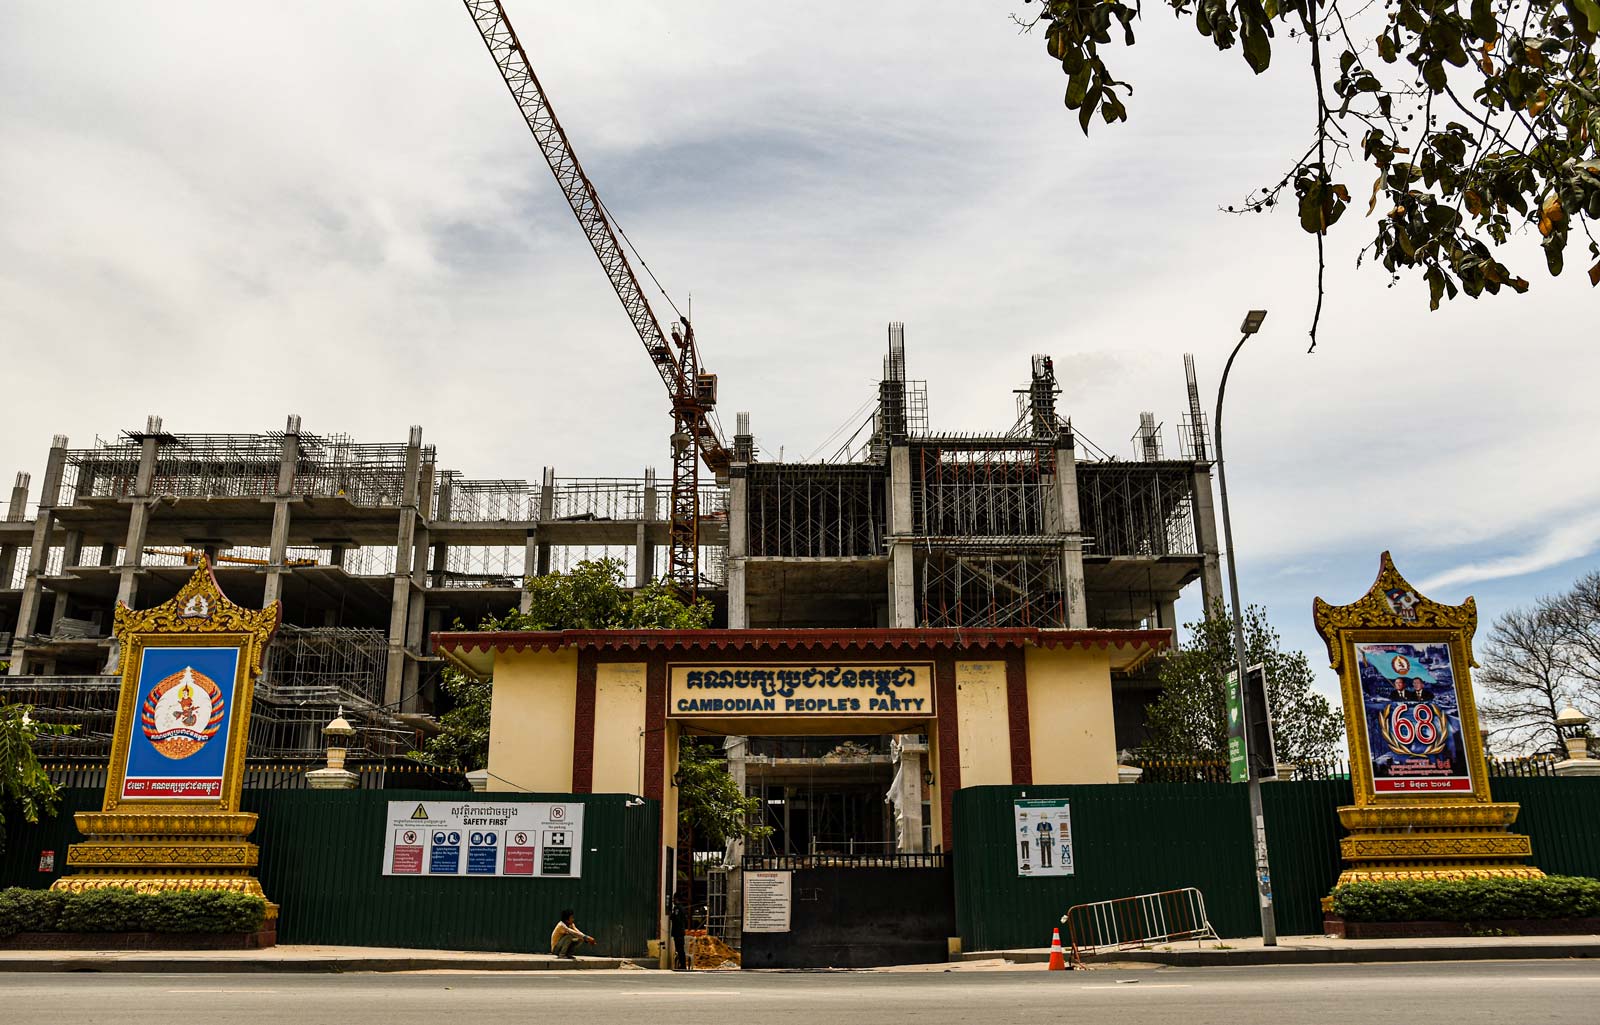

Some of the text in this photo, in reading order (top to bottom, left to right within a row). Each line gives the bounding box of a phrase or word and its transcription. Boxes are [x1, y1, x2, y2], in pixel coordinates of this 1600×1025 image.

[687, 667, 915, 698] គណបក្សប្រជាជនកម្ពុជា
[677, 698, 925, 711] CAMBODIAN PEOPLE'S PARTY
[1392, 704, 1437, 744] 68
[463, 818, 508, 826] SAFETY FIRST
